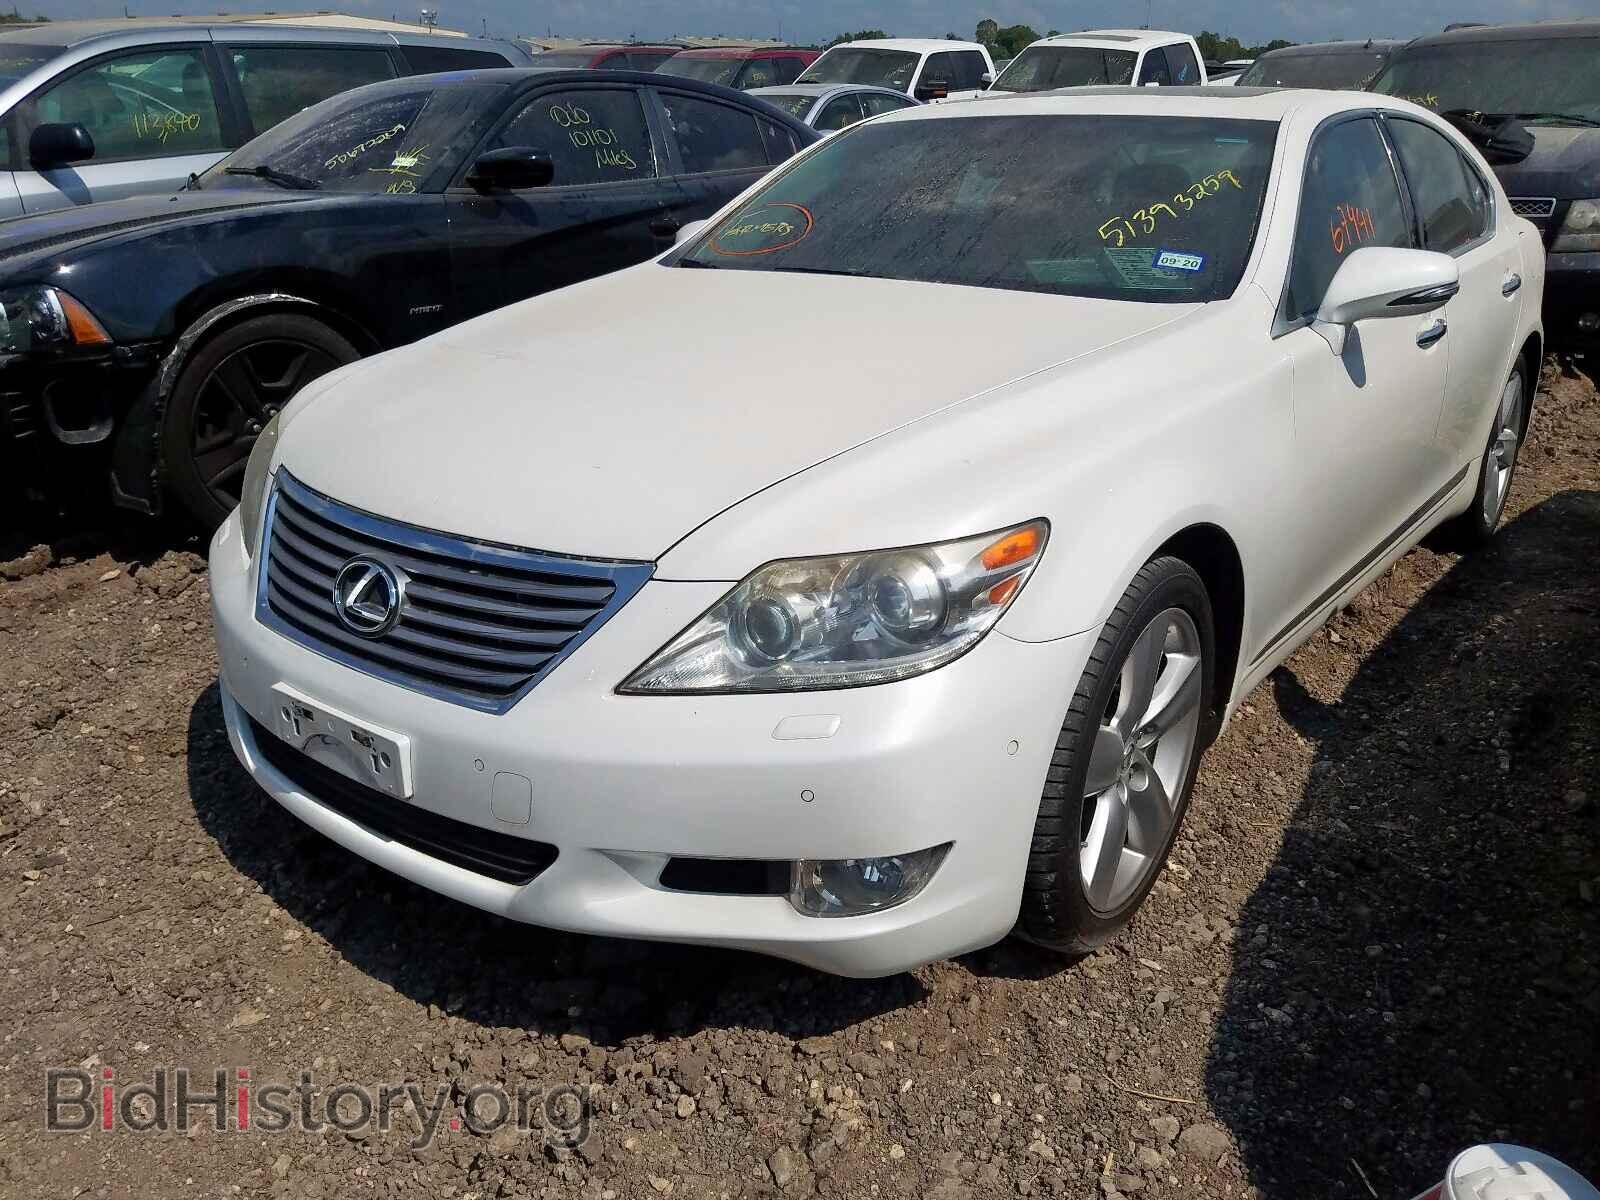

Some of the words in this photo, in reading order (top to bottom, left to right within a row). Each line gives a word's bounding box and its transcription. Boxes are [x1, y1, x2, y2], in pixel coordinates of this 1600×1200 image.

[1098, 169, 1242, 247] 51393259
[1161, 256, 1177, 265] 09
[1182, 259, 1199, 268] 20
